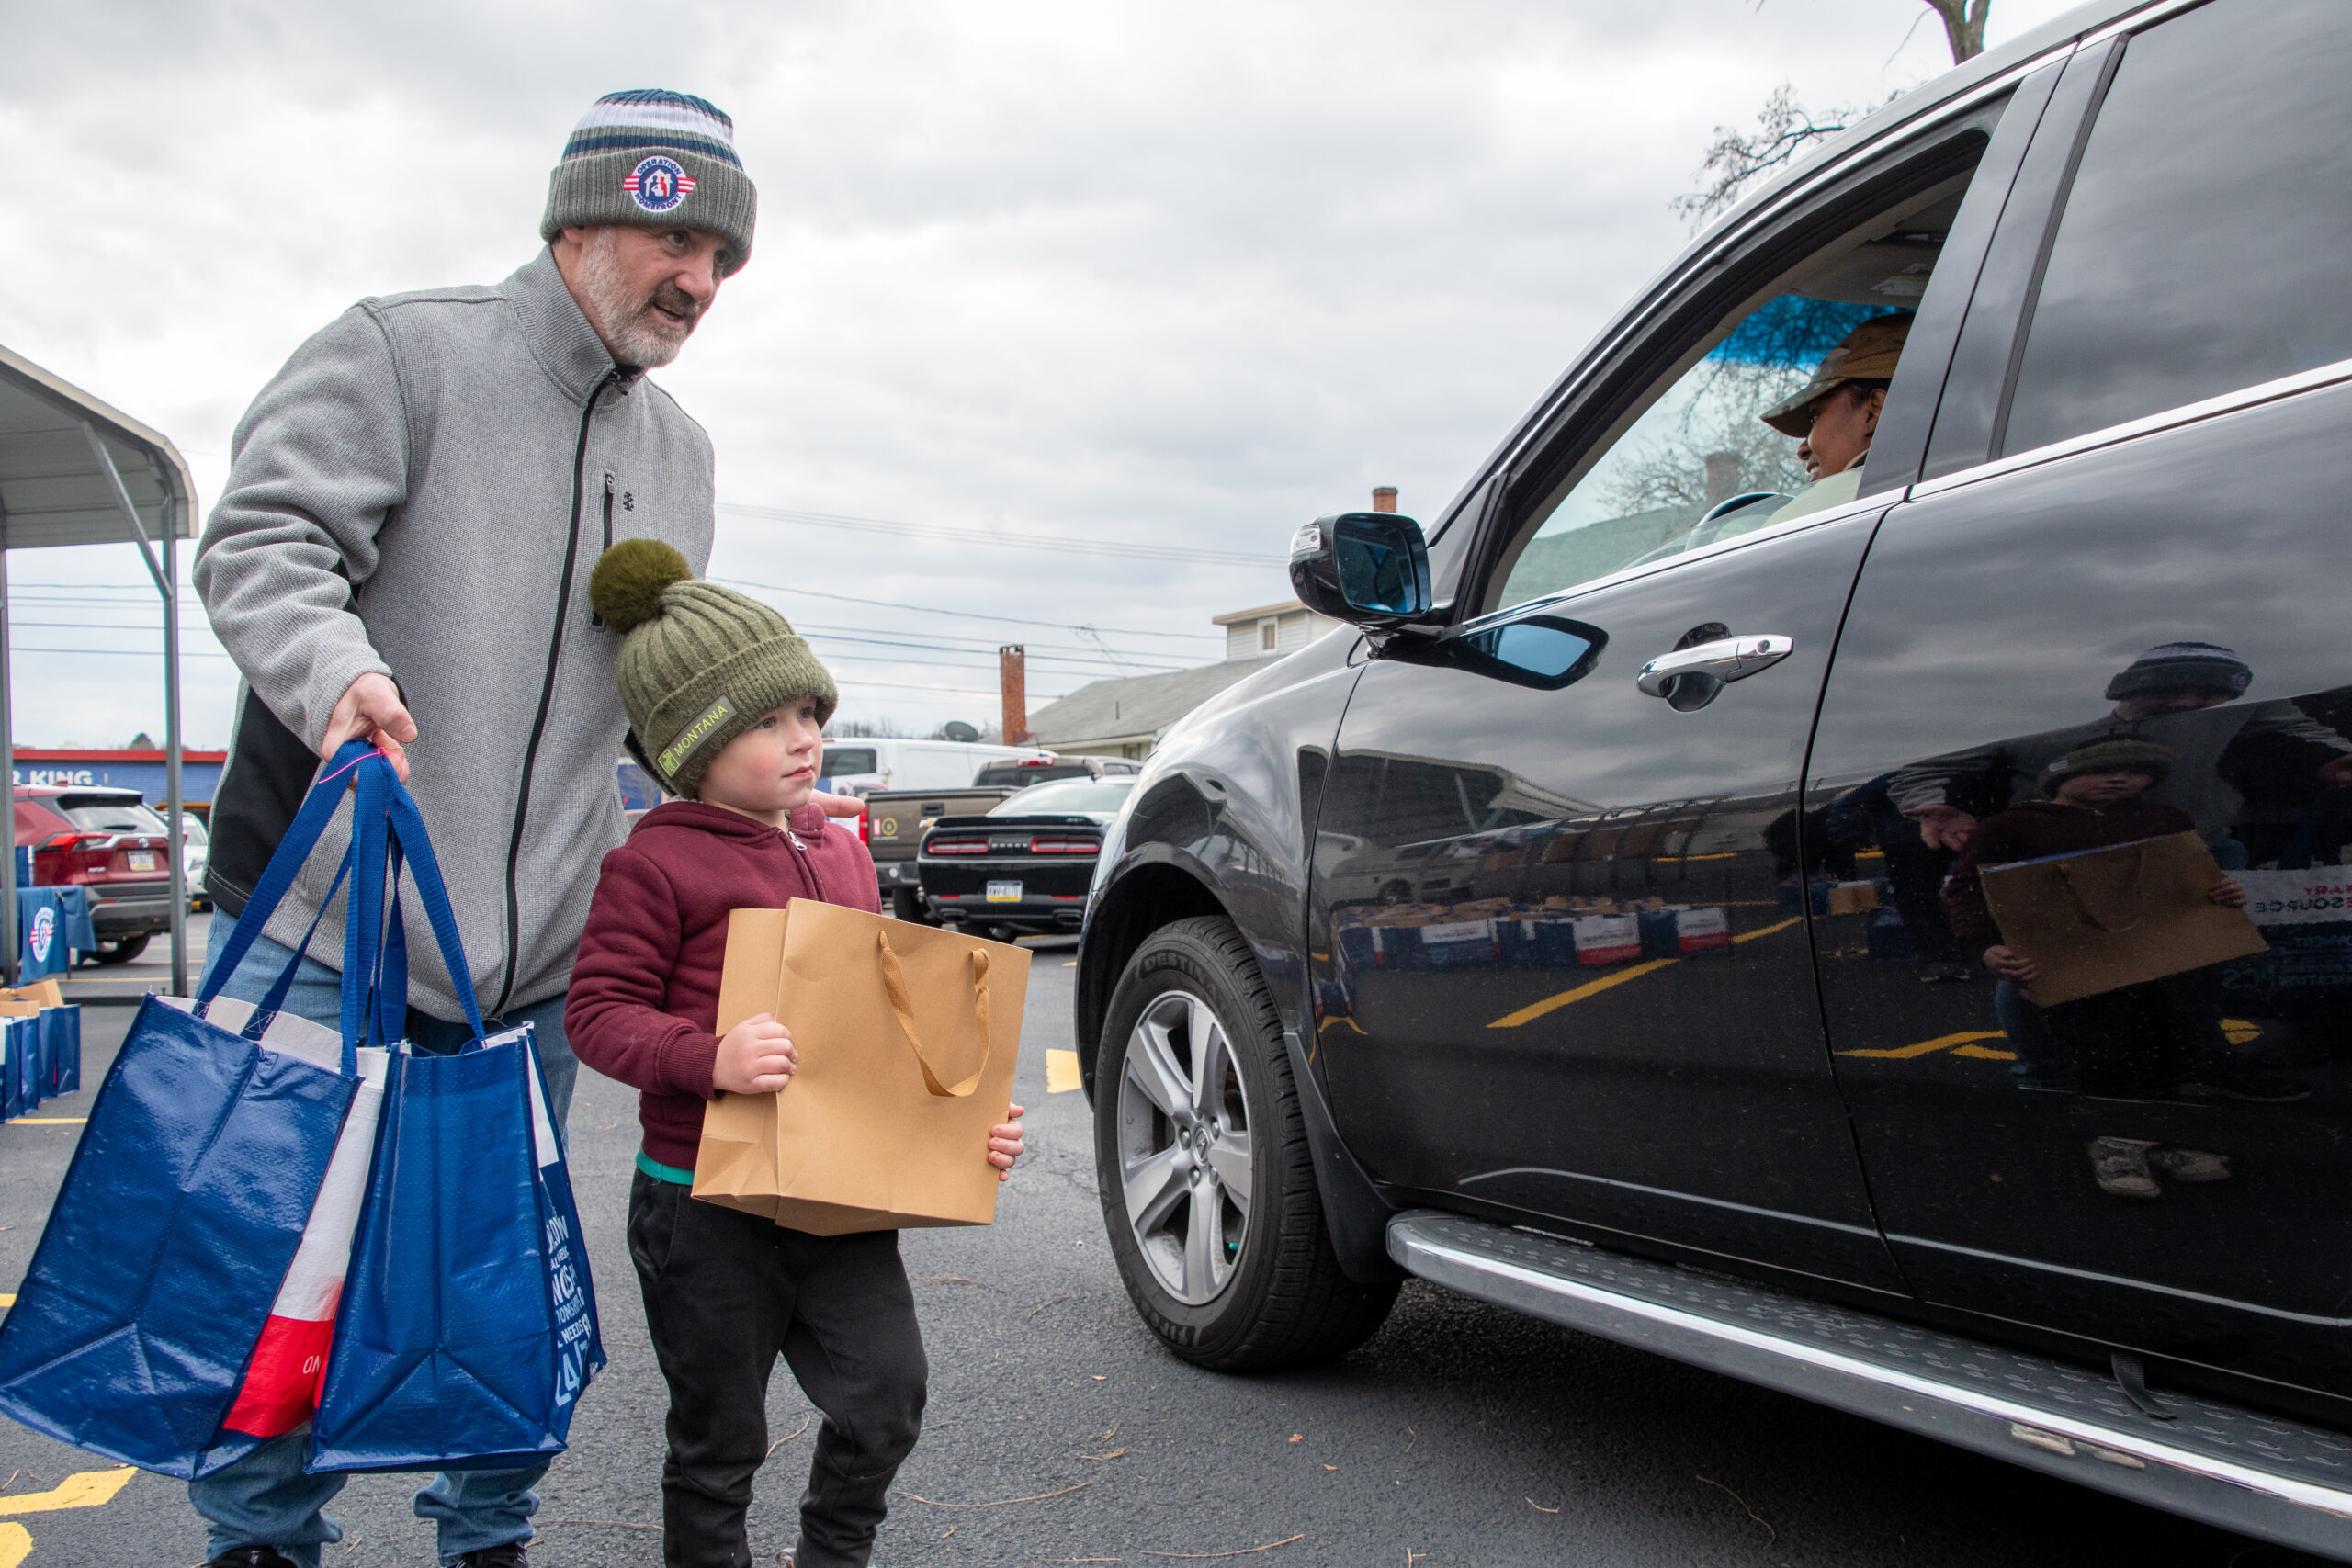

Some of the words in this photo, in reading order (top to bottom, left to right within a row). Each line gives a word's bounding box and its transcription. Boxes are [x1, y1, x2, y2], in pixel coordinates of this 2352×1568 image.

[637, 158, 683, 175] OPERATION
[634, 192, 682, 210] HOMEFRONT
[673, 705, 729, 757] MONTANA
[29, 770, 93, 785] KING
